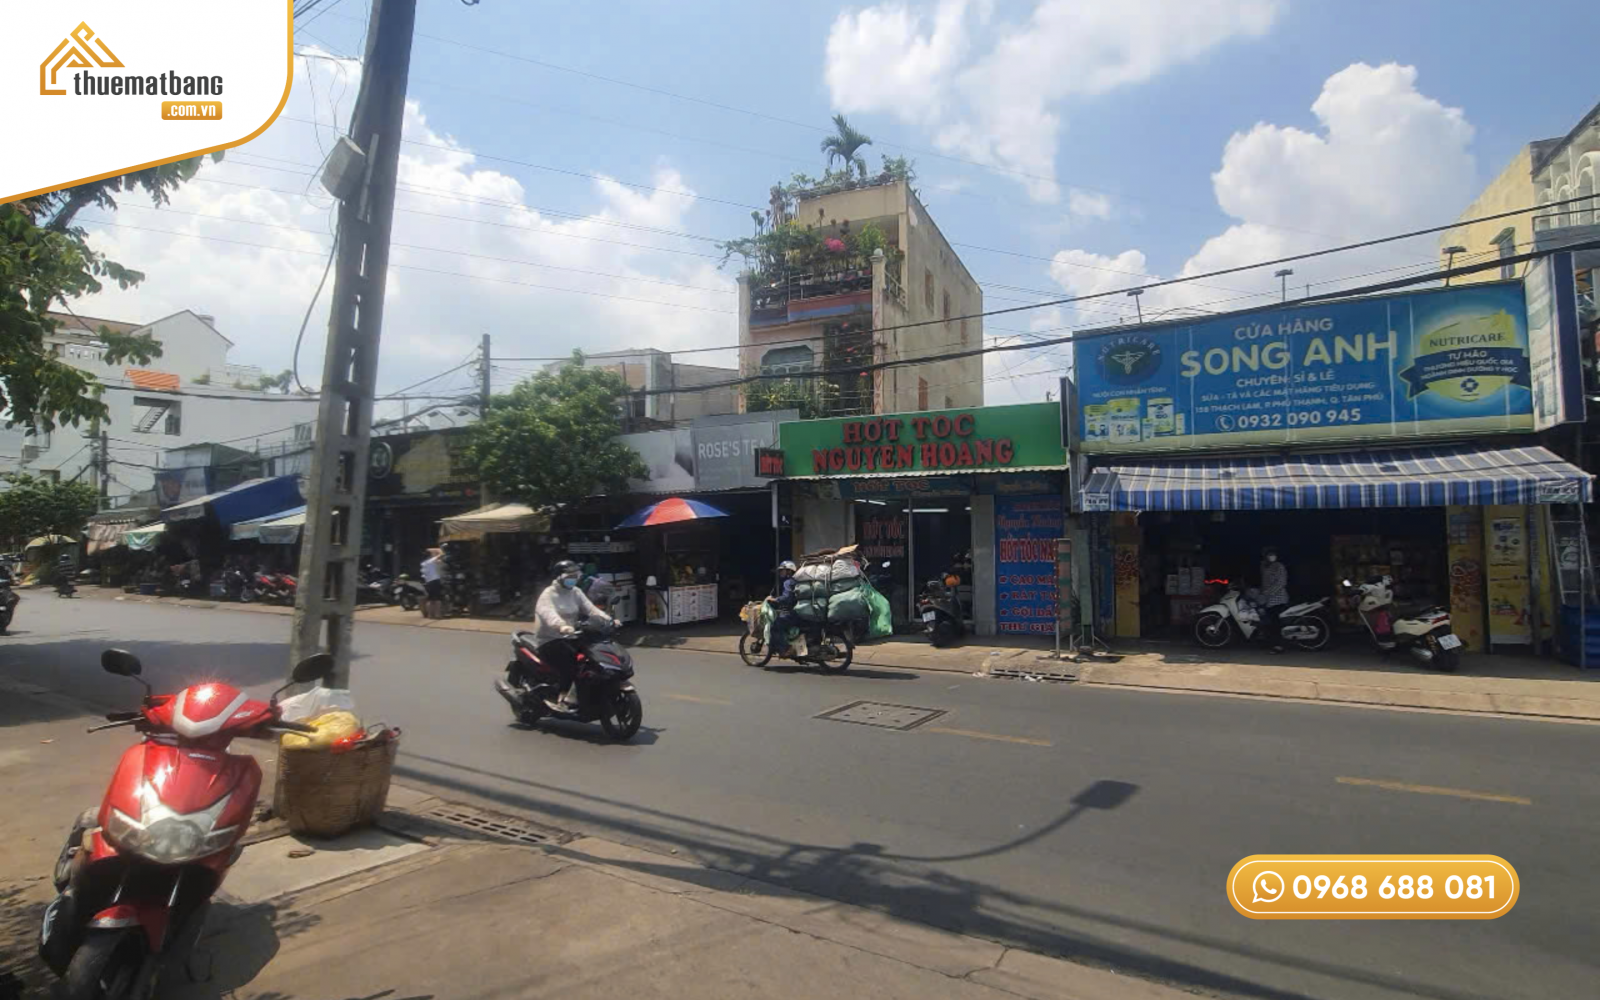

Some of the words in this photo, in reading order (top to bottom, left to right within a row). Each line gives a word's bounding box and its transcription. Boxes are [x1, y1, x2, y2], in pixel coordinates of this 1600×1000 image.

[1234, 322, 1273, 340] CỬA
[1278, 317, 1334, 336] HÀNG
[1430, 333, 1506, 348] NUTRICARE
[1180, 341, 1291, 377] SONG
[1303, 330, 1398, 366] ANH
[1307, 373, 1317, 382] &
[1238, 413, 1282, 428] 0932
[1287, 410, 1321, 426] 090
[1326, 408, 1361, 423] 945
[699, 440, 740, 459] ROSE'S
